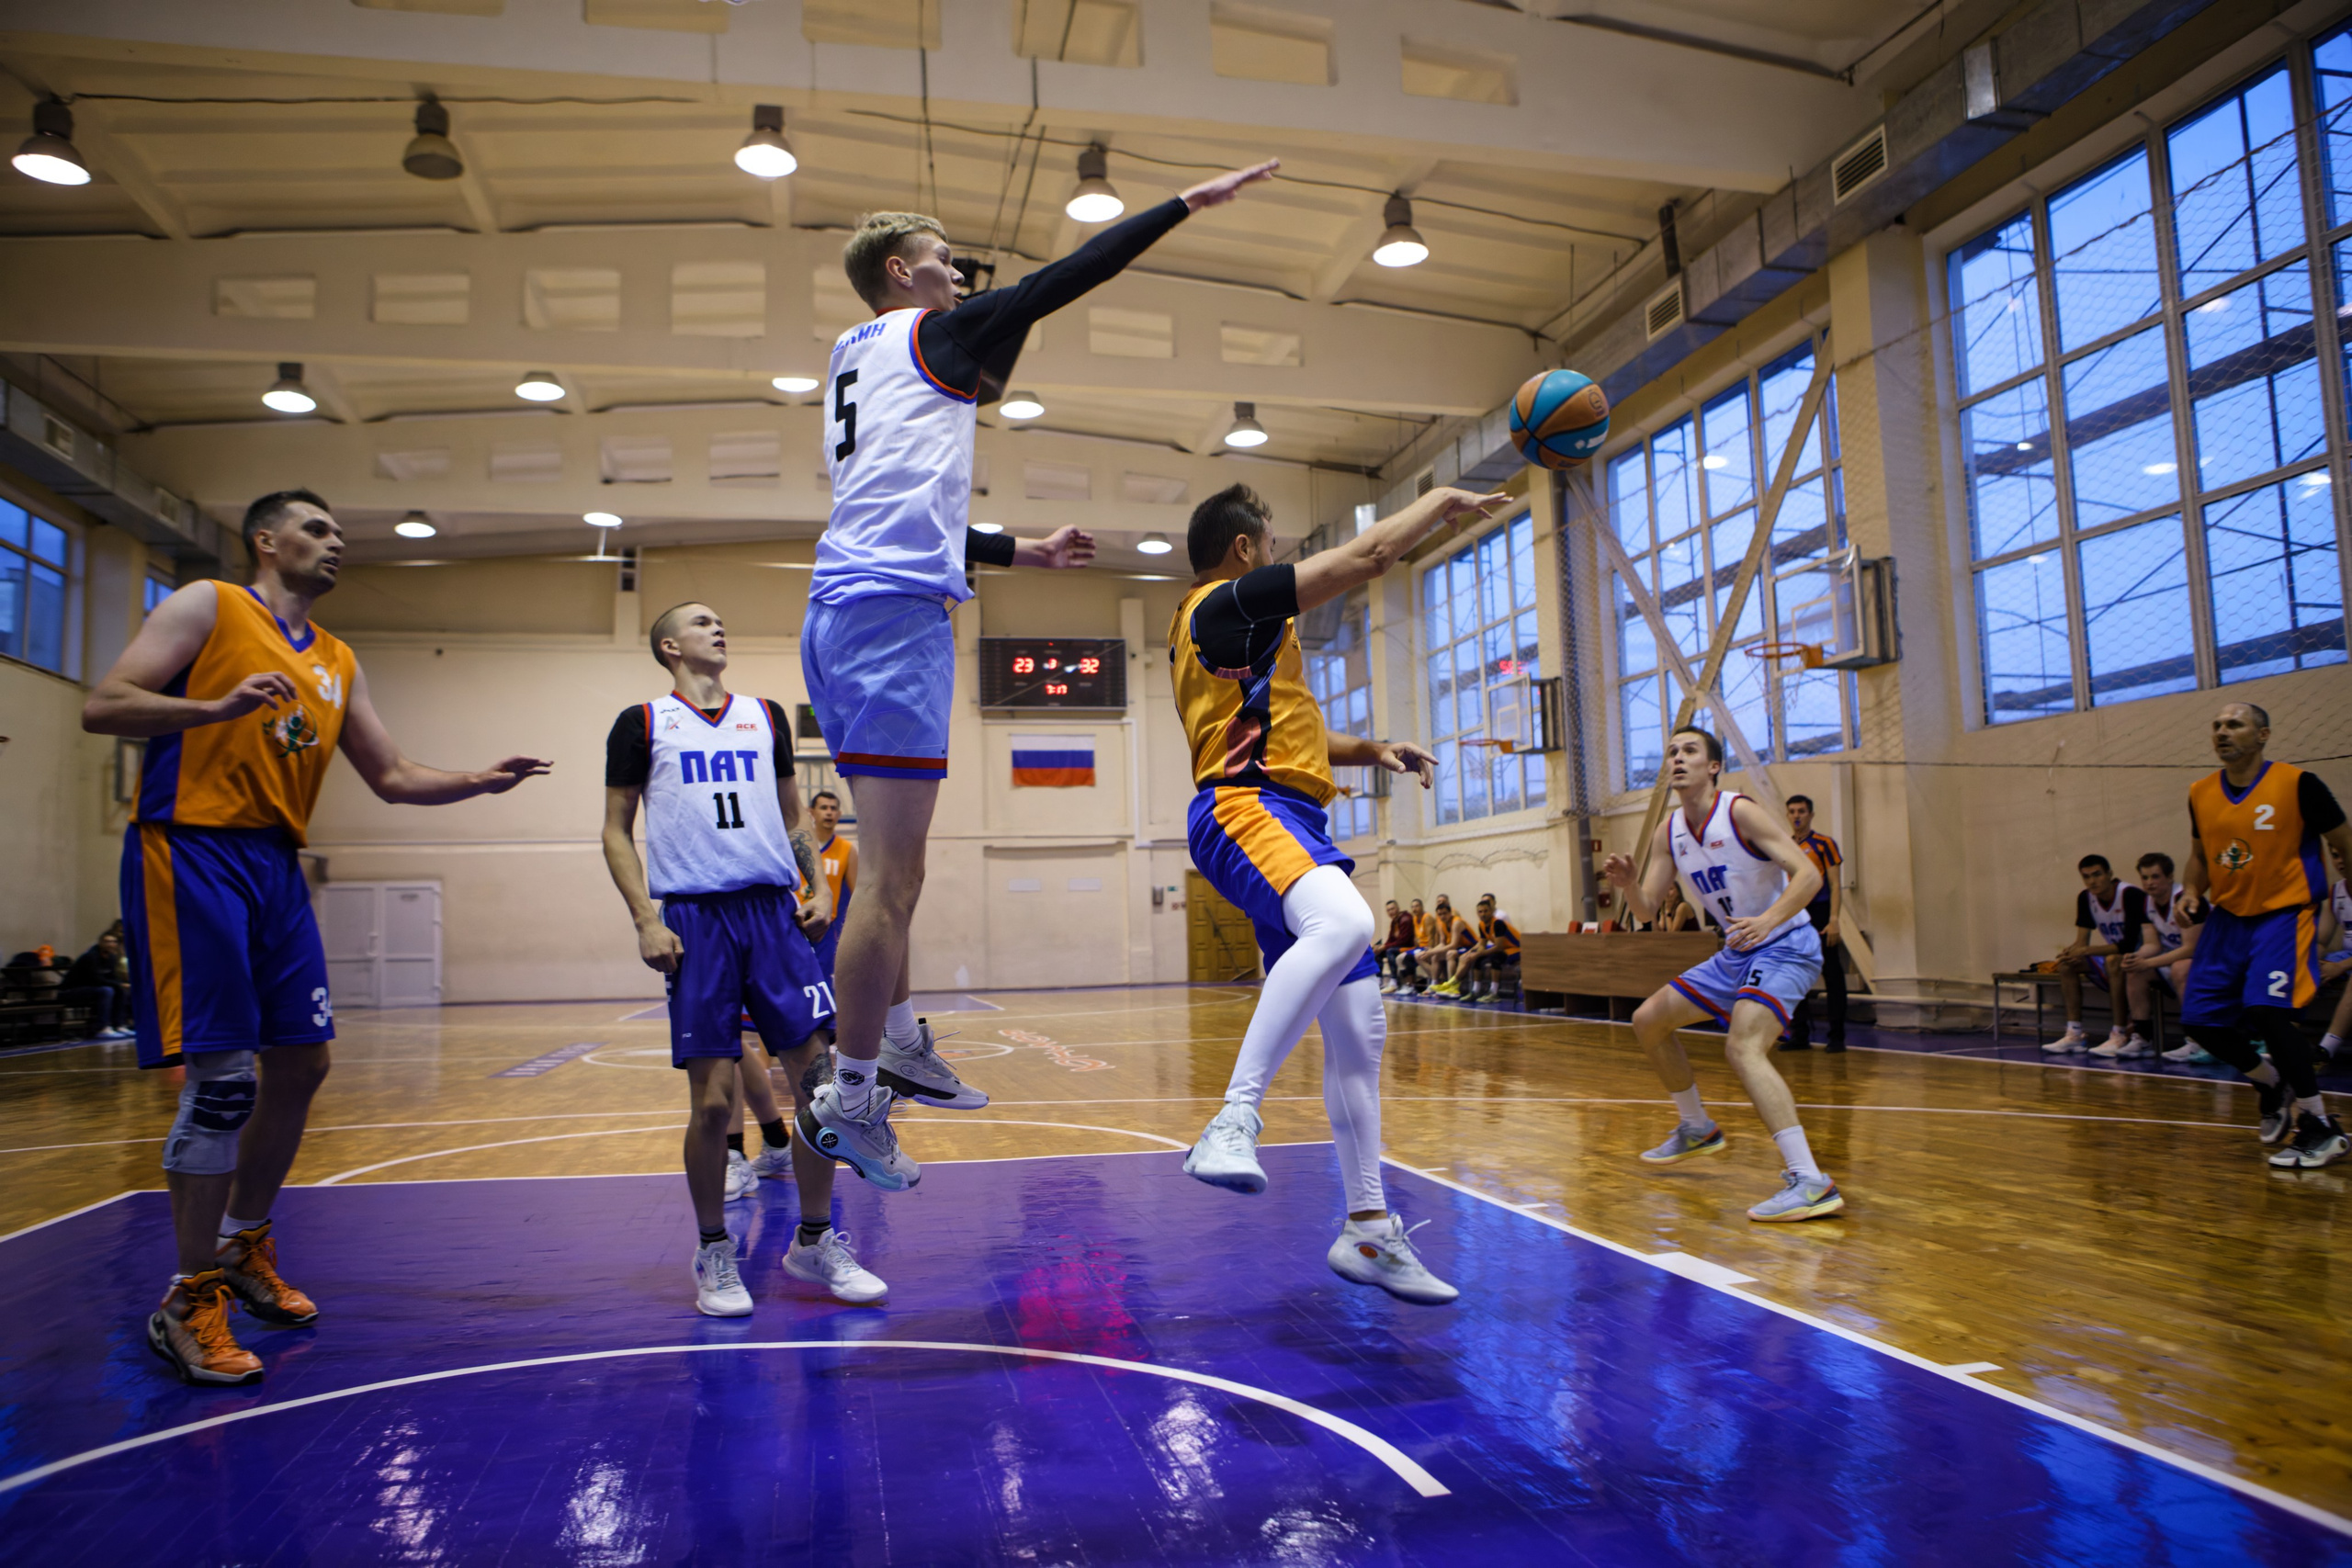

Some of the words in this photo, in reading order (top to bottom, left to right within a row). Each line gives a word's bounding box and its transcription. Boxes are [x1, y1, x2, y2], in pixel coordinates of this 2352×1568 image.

[834, 368, 859, 462] 5
[1012, 657, 1035, 673] 23
[1047, 658, 1057, 670] 3
[1080, 658, 1100, 674] 32
[312, 665, 343, 710] 34
[679, 750, 759, 784] ПАТ
[712, 792, 745, 829] 11
[2254, 804, 2275, 830] 2
[825, 858, 840, 876] 11
[1690, 864, 1727, 895] ПАТ
[2267, 970, 2289, 998] 2
[803, 981, 837, 1020] 21
